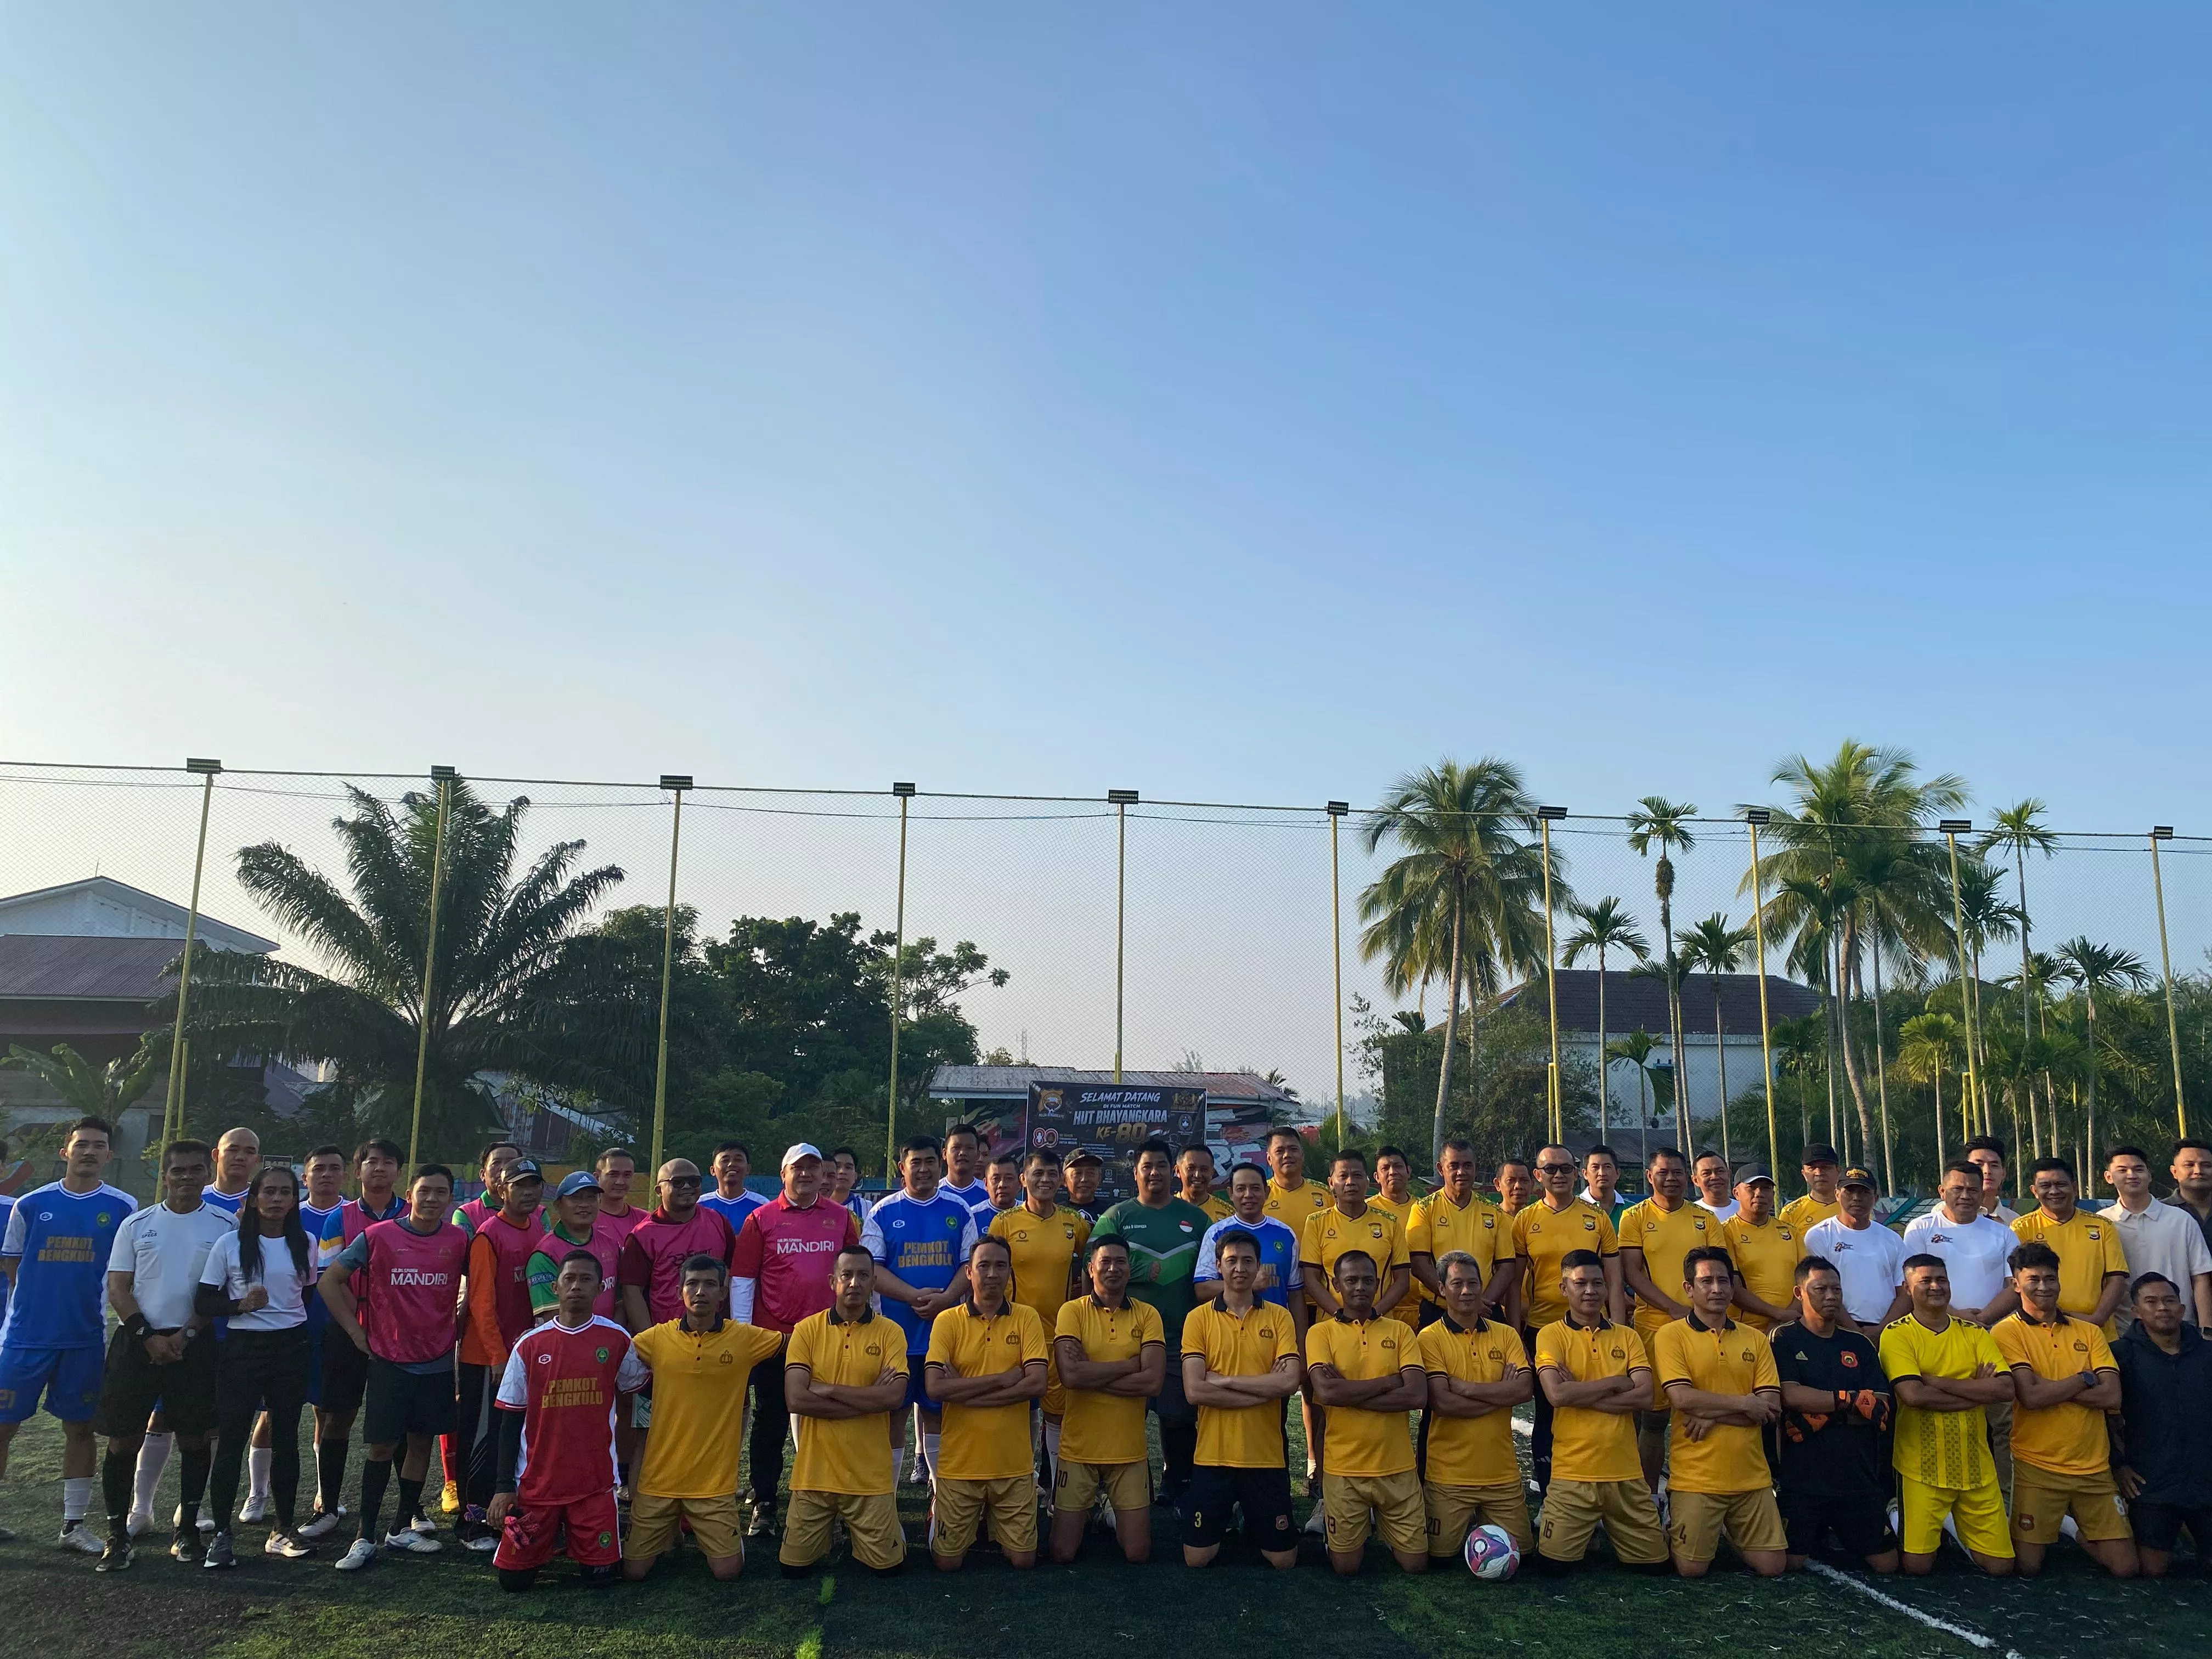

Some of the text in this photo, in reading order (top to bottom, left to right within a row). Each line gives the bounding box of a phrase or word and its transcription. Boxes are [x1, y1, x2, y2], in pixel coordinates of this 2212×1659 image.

[1080, 1092, 1161, 1103] SELAMAT DATANG
[1073, 1109, 1167, 1125] HUT BHAYANGKARA
[1096, 1122, 1148, 1143] KE-80
[46, 1236, 94, 1250] PEMKOT
[777, 1240, 834, 1255] MANDIRI
[904, 1240, 949, 1254] PEMKOT
[391, 1273, 448, 1285] MANDIRI
[549, 1377, 597, 1393] PEMKOT
[541, 1391, 603, 1409] BENGKULU
[1195, 1511, 1201, 1528] 3
[937, 1520, 946, 1540] 14
[1543, 1519, 1554, 1539] 16
